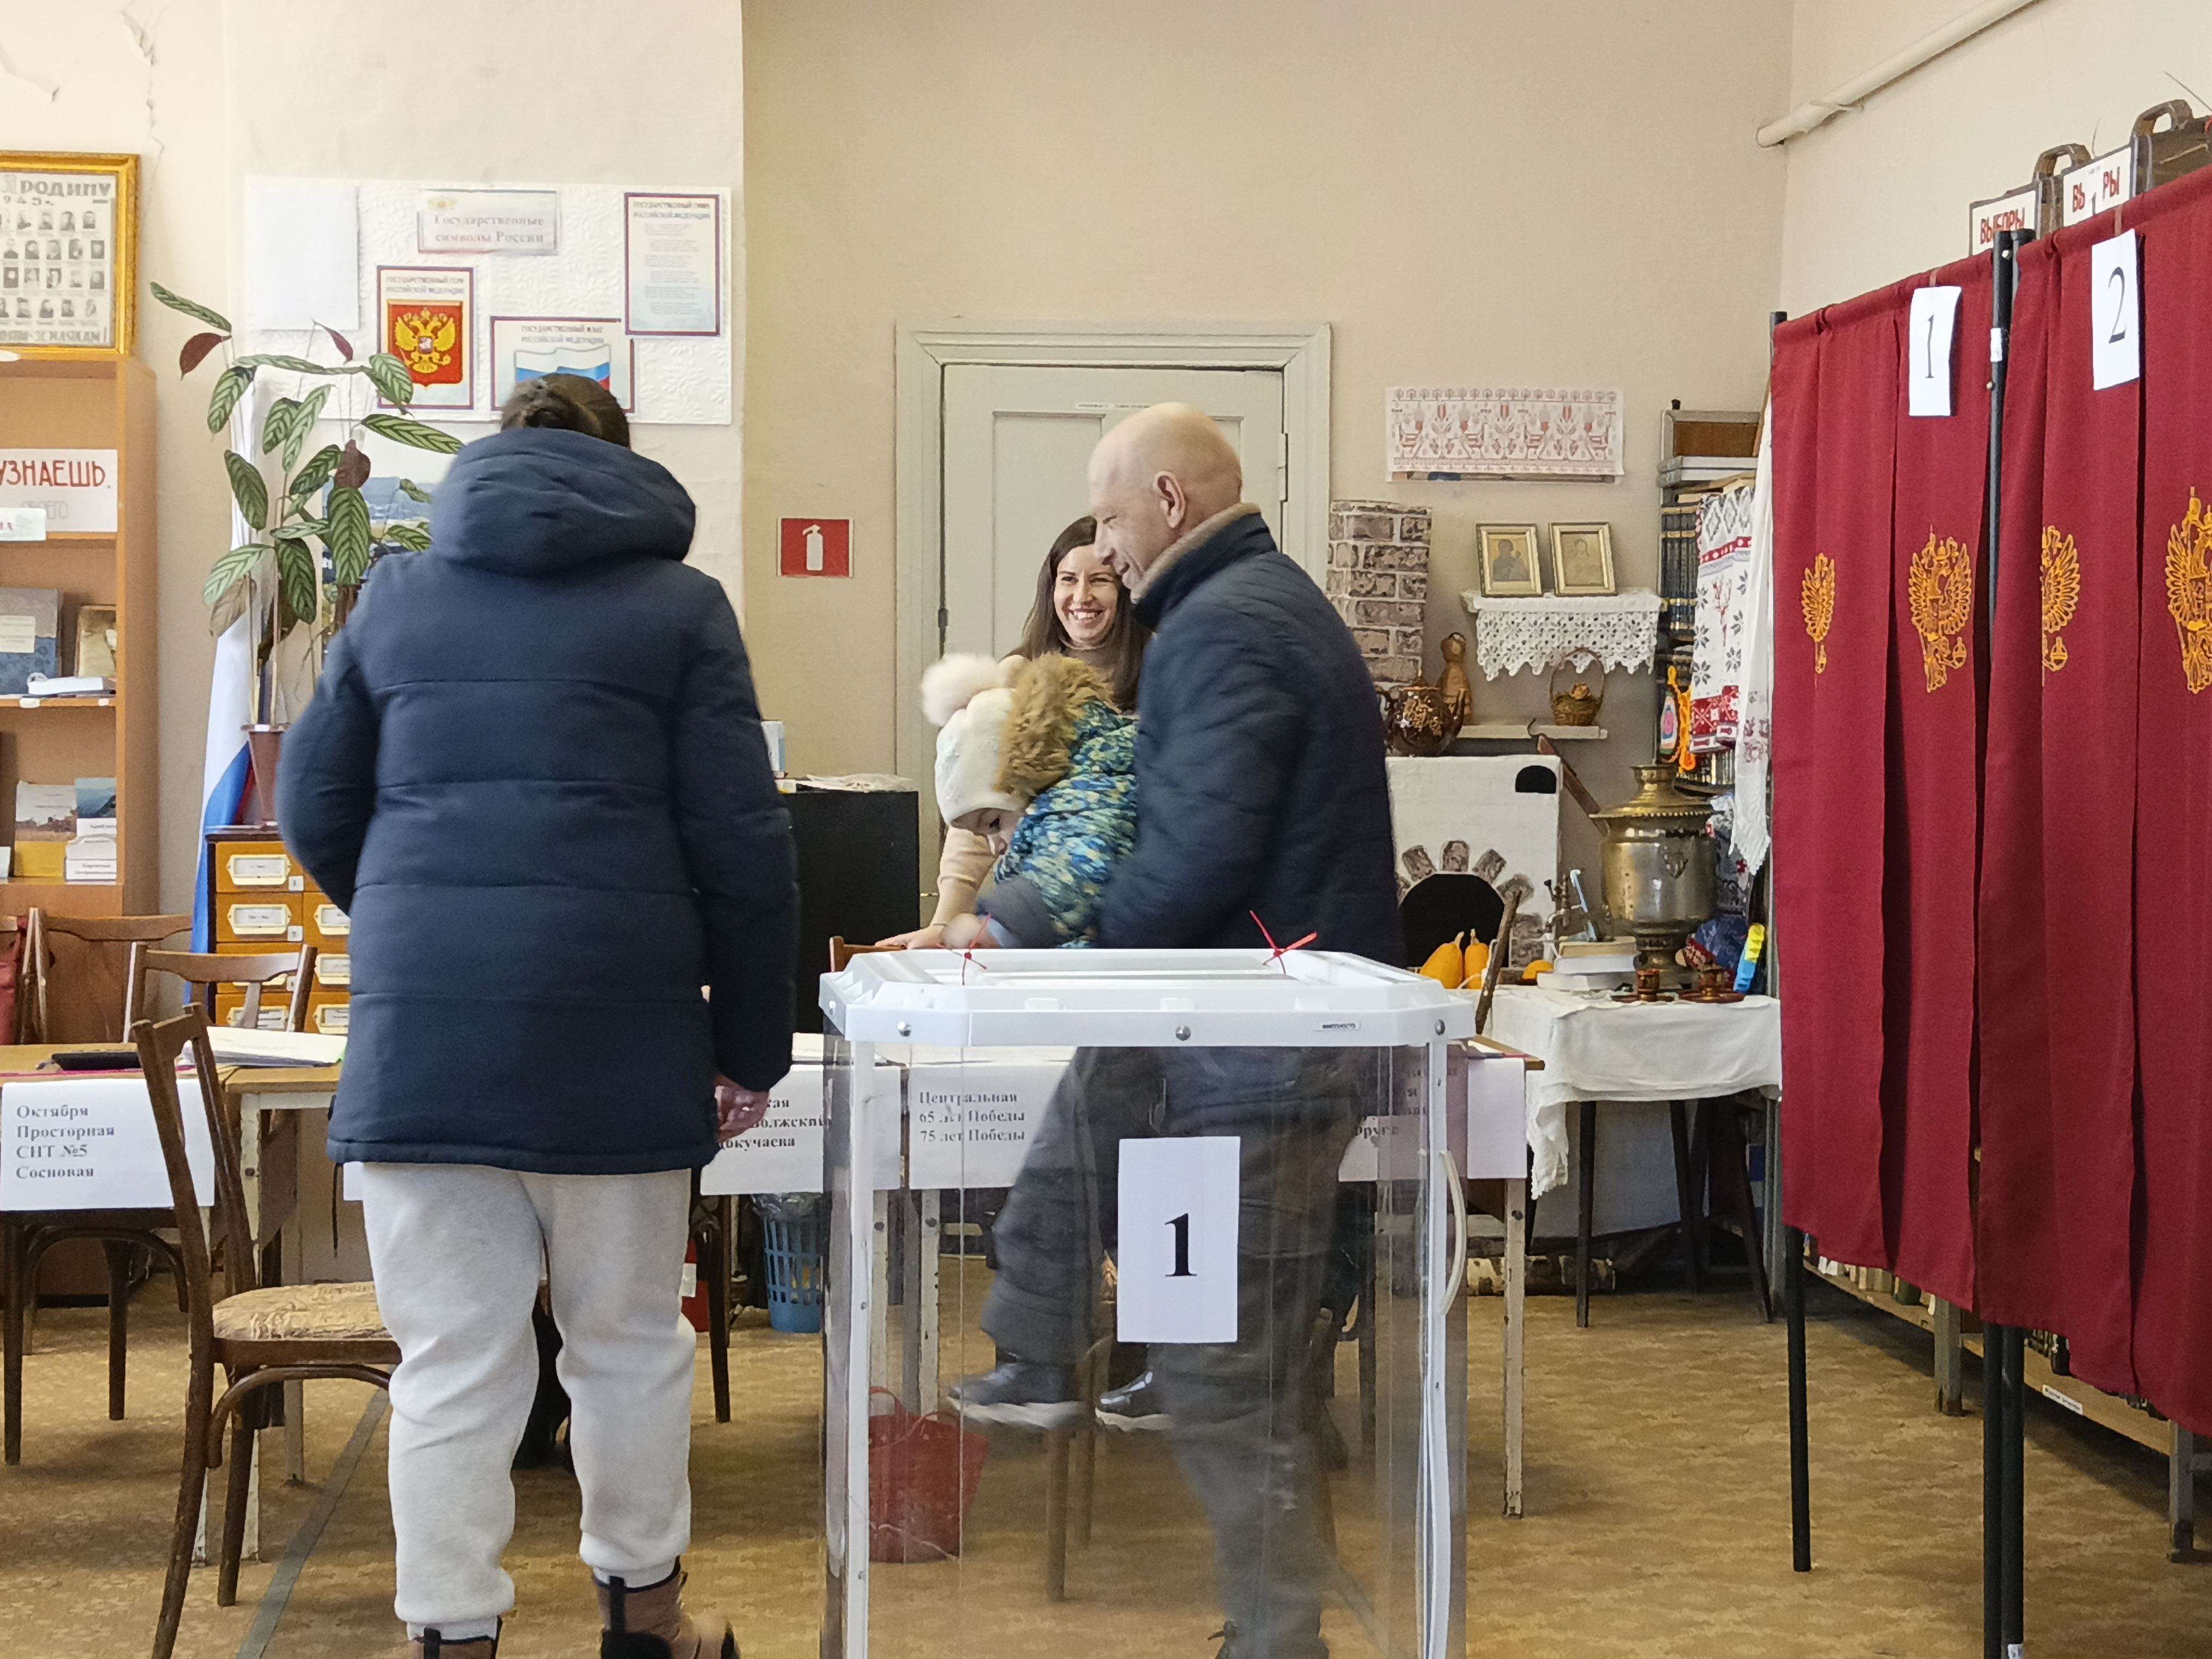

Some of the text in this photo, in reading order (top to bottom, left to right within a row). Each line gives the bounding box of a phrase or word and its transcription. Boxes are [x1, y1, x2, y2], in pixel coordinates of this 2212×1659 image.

[435, 214, 544, 227] Государственные
[435, 230, 544, 243] символы России
[2107, 267, 2127, 343] 2
[1925, 314, 1935, 378] 1
[920, 1091, 1017, 1107] Центральная
[17, 1104, 88, 1120] Октября
[919, 1111, 935, 1123] 65
[968, 1109, 1025, 1122] Победы
[17, 1125, 114, 1141] Просторная
[920, 1128, 1025, 1142] 75 лет Победы
[16, 1145, 56, 1159] СНТ
[16, 1165, 94, 1179] Сосновая
[1164, 1212, 1197, 1277] 1
